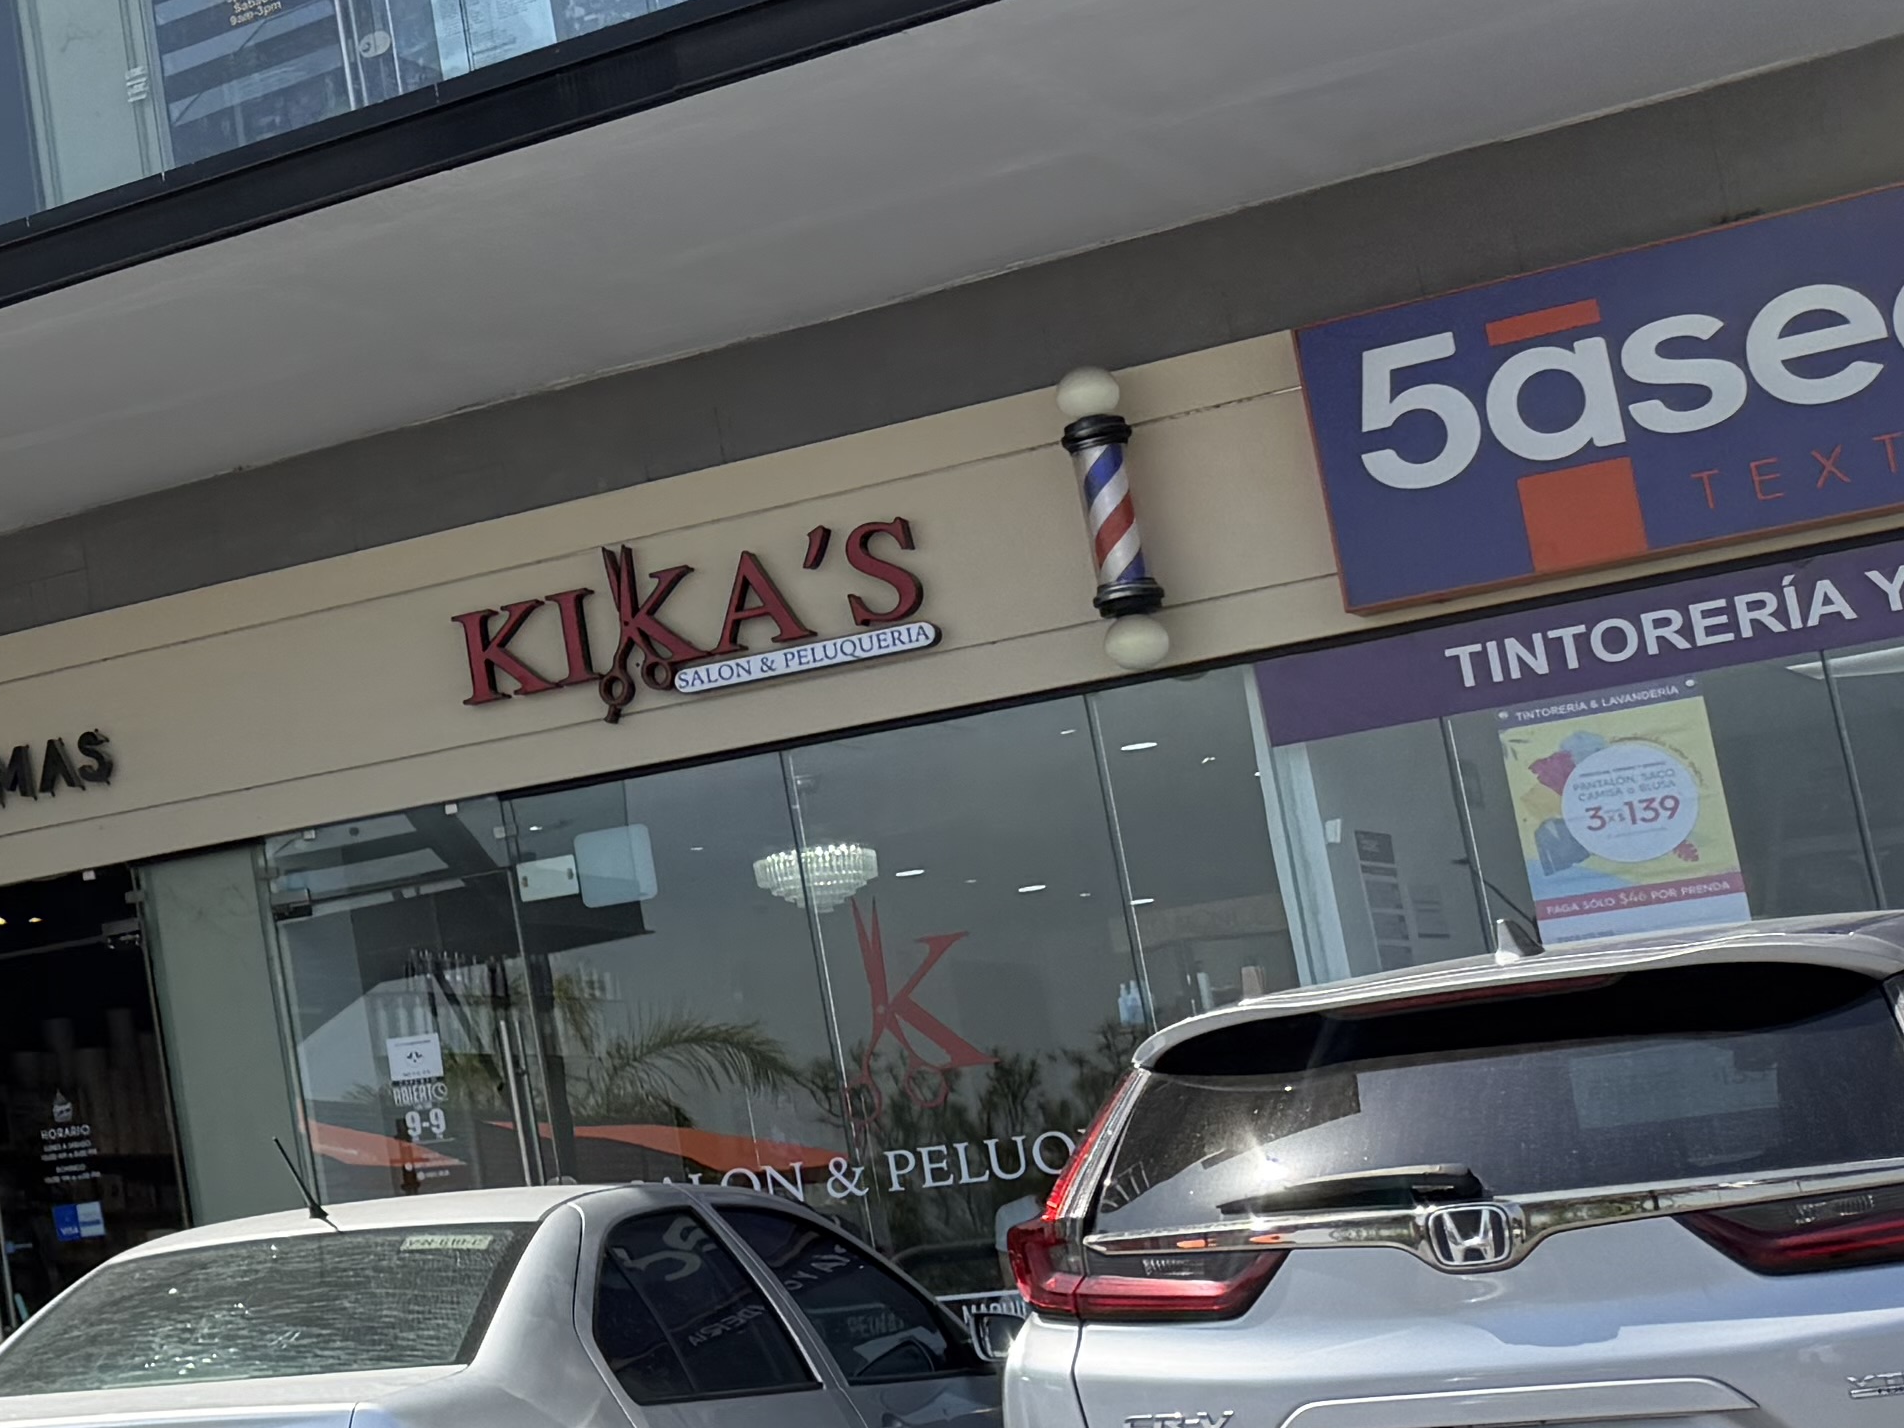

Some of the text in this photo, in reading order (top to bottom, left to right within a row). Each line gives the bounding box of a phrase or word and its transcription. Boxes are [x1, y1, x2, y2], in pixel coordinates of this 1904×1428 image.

[451, 516, 925, 724] KIKA'S
[1444, 574, 1858, 689] TINTORERÍA
[677, 624, 932, 691] SALON & PELUQUERIA
[1515, 701, 1588, 722] TINTORERÍA
[1600, 684, 1680, 707] LAVANDERÍA
[1546, 903, 1581, 916] PAGA
[1650, 888, 1678, 901] POR
[1680, 881, 1731, 897] PRENDA
[40, 1124, 91, 1140] HORARIO
[405, 1107, 446, 1137] 9-9
[825, 1156, 870, 1200] &
